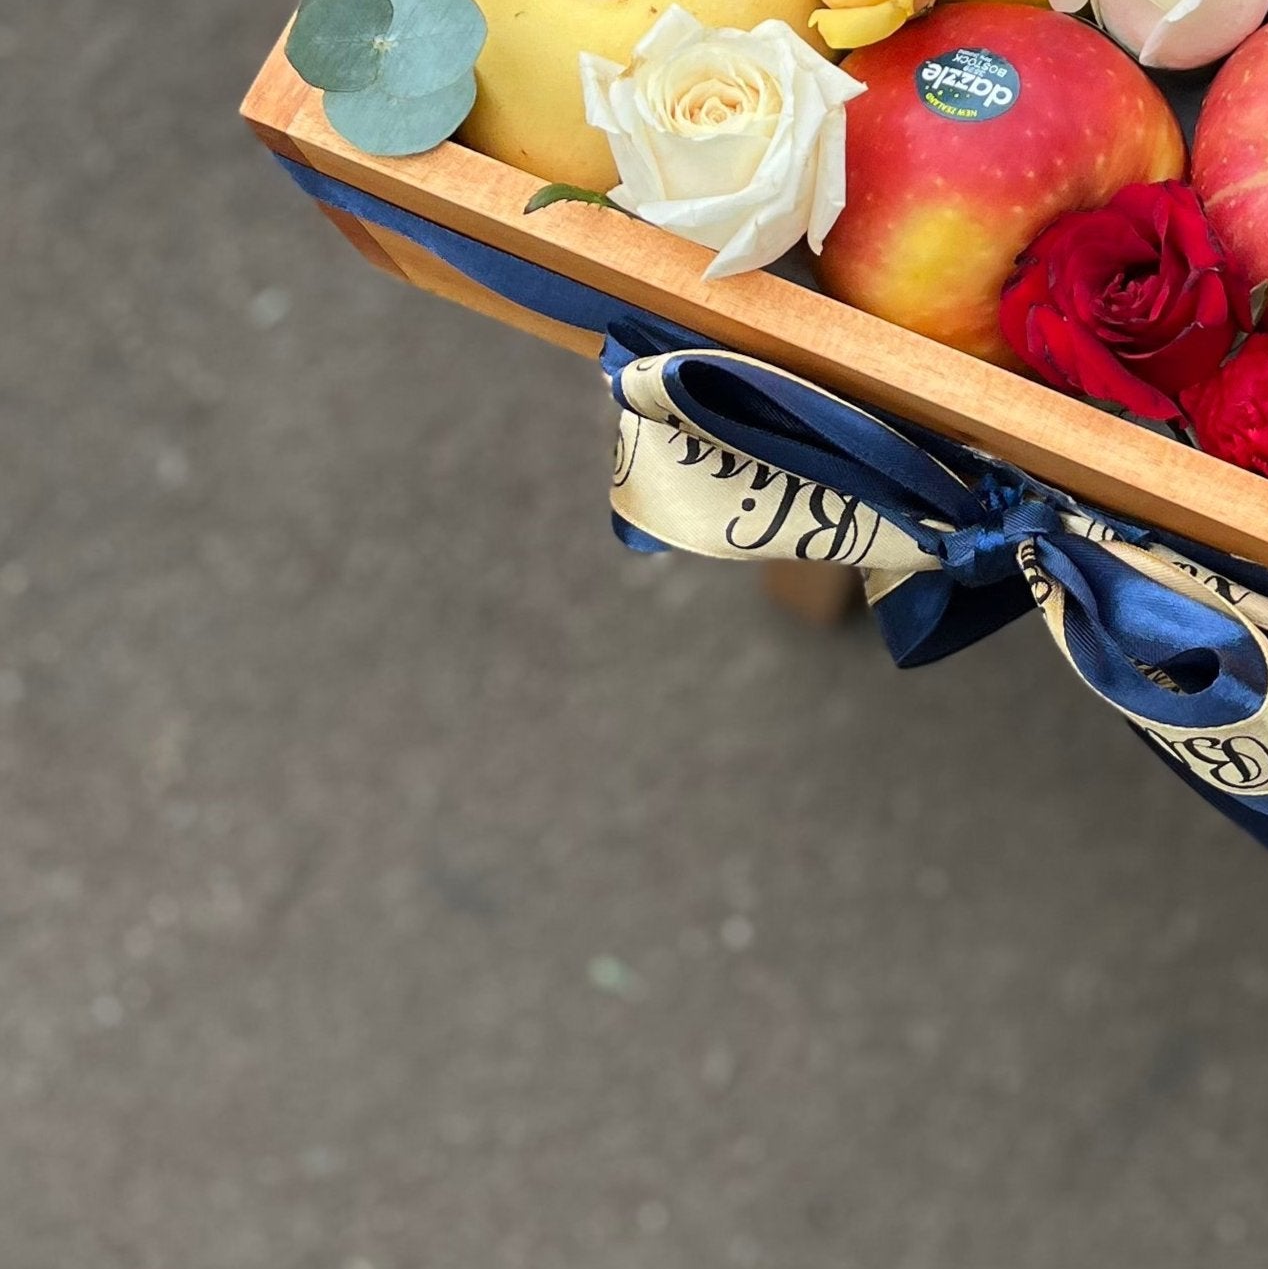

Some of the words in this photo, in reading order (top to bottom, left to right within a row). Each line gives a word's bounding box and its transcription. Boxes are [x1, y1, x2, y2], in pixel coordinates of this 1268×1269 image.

[952, 53, 1008, 78] BOSTOCK
[921, 63, 1013, 108] dazzle
[925, 92, 957, 115] ZEALAND
[957, 108, 978, 118] NEW
